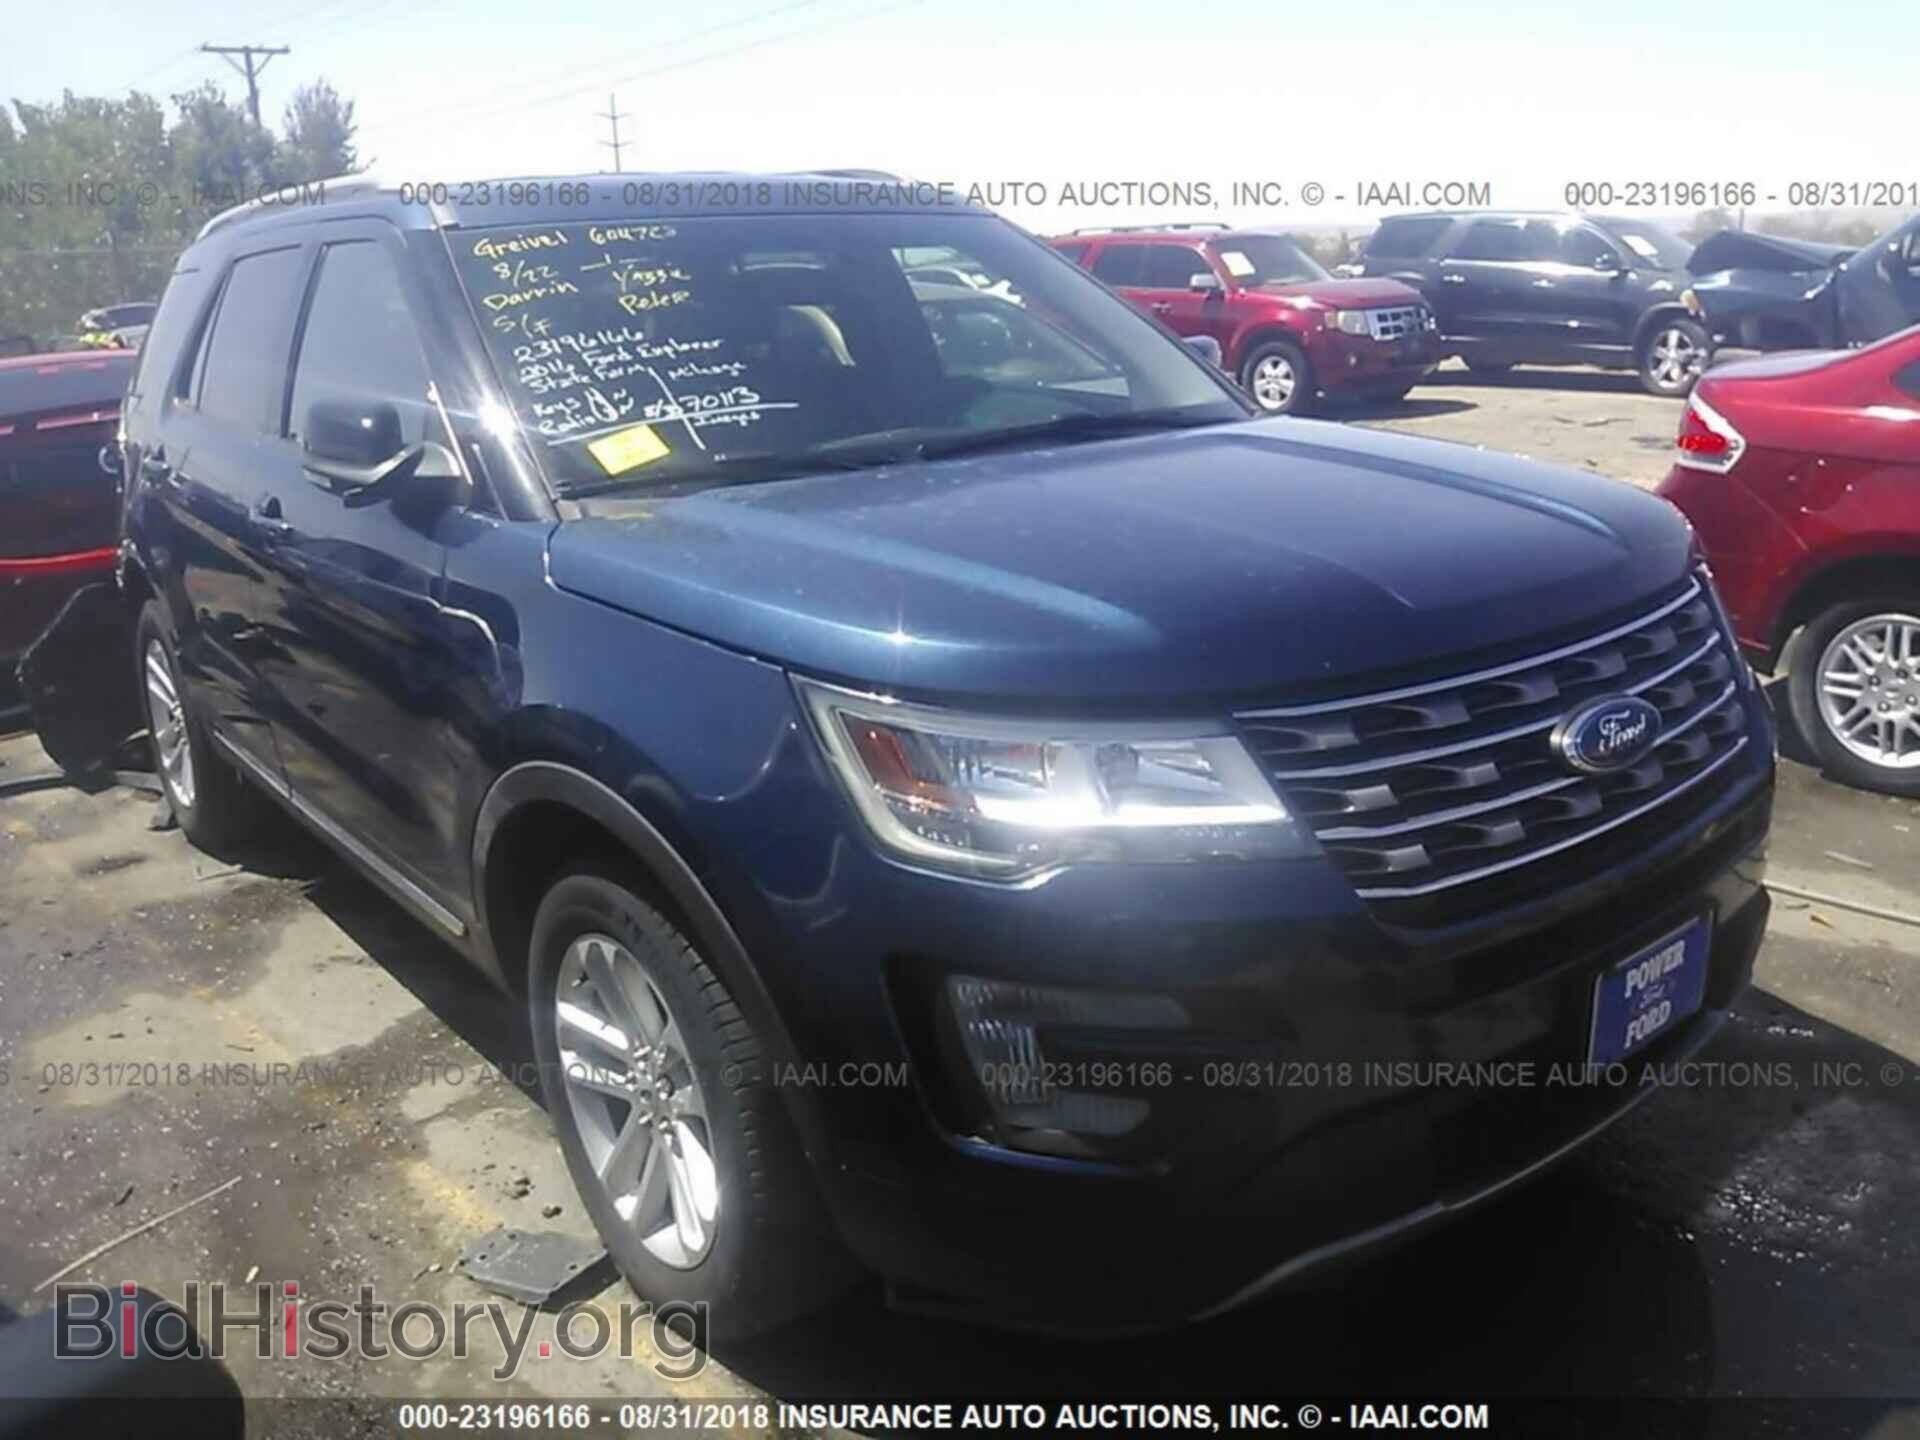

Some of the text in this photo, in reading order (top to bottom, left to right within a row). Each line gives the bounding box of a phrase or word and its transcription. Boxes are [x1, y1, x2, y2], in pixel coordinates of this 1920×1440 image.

[513, 328, 645, 363] 23196166
[1599, 710, 1646, 752] Ford
[1624, 939, 1686, 999] POWER
[1624, 1001, 1672, 1050] FORD
